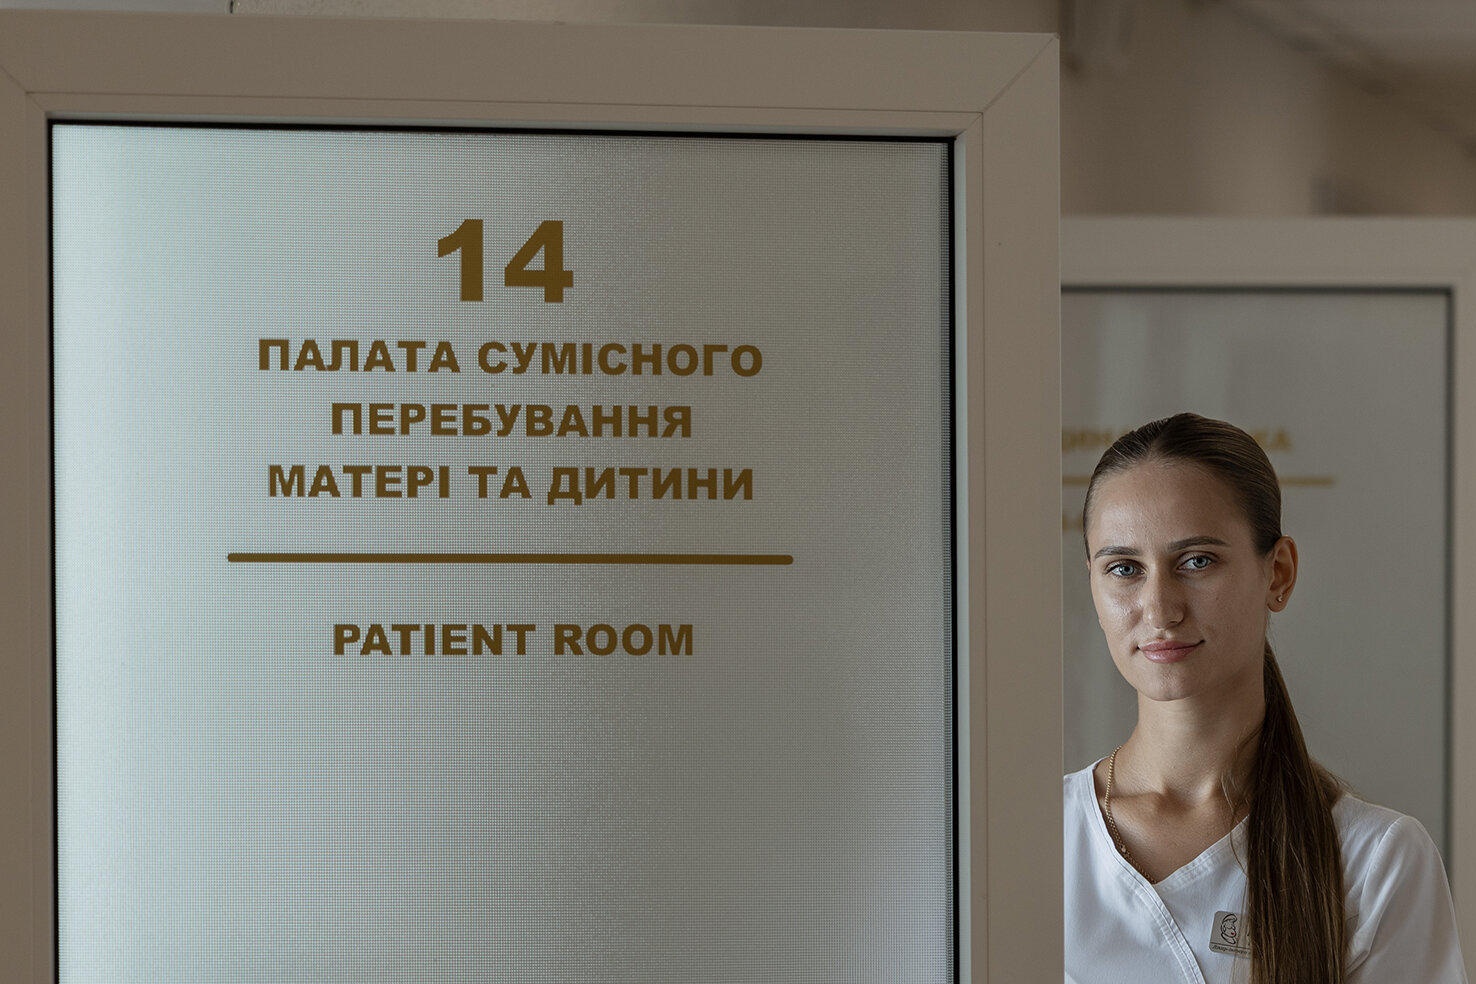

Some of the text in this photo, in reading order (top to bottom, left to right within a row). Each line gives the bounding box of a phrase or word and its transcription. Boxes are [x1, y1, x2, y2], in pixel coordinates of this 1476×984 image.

[437, 219, 574, 304] 14
[258, 338, 764, 377] ПАЛАТА СУМІСНОГО
[331, 403, 692, 438] ПЕРЕБУВАННЯ
[268, 464, 753, 506] МАТЕРІ ТА ДИТИНИ
[333, 624, 694, 656] PATIENT ROOM
